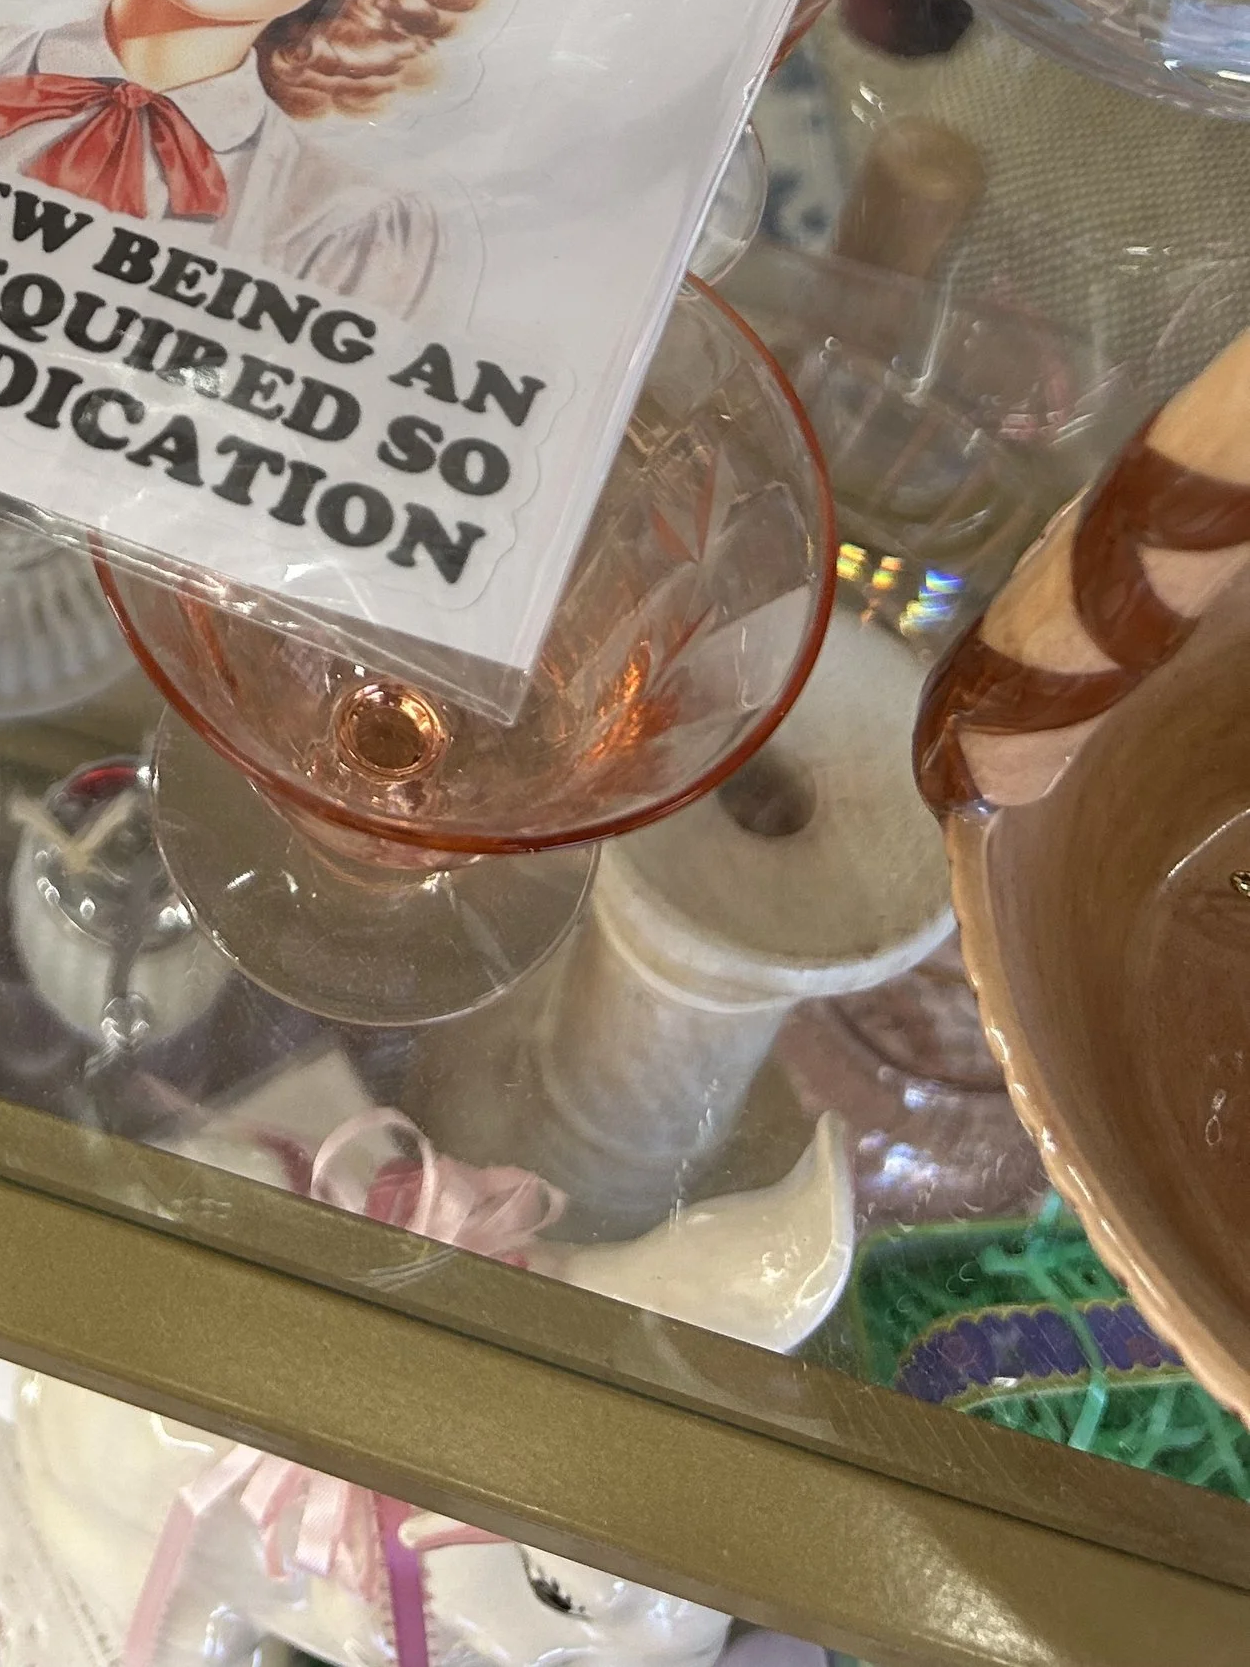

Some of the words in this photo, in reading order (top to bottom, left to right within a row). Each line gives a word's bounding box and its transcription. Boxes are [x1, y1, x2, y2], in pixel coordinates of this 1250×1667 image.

[93, 227, 376, 364] BEING
[388, 342, 547, 427] AN
[377, 414, 511, 497] SO
